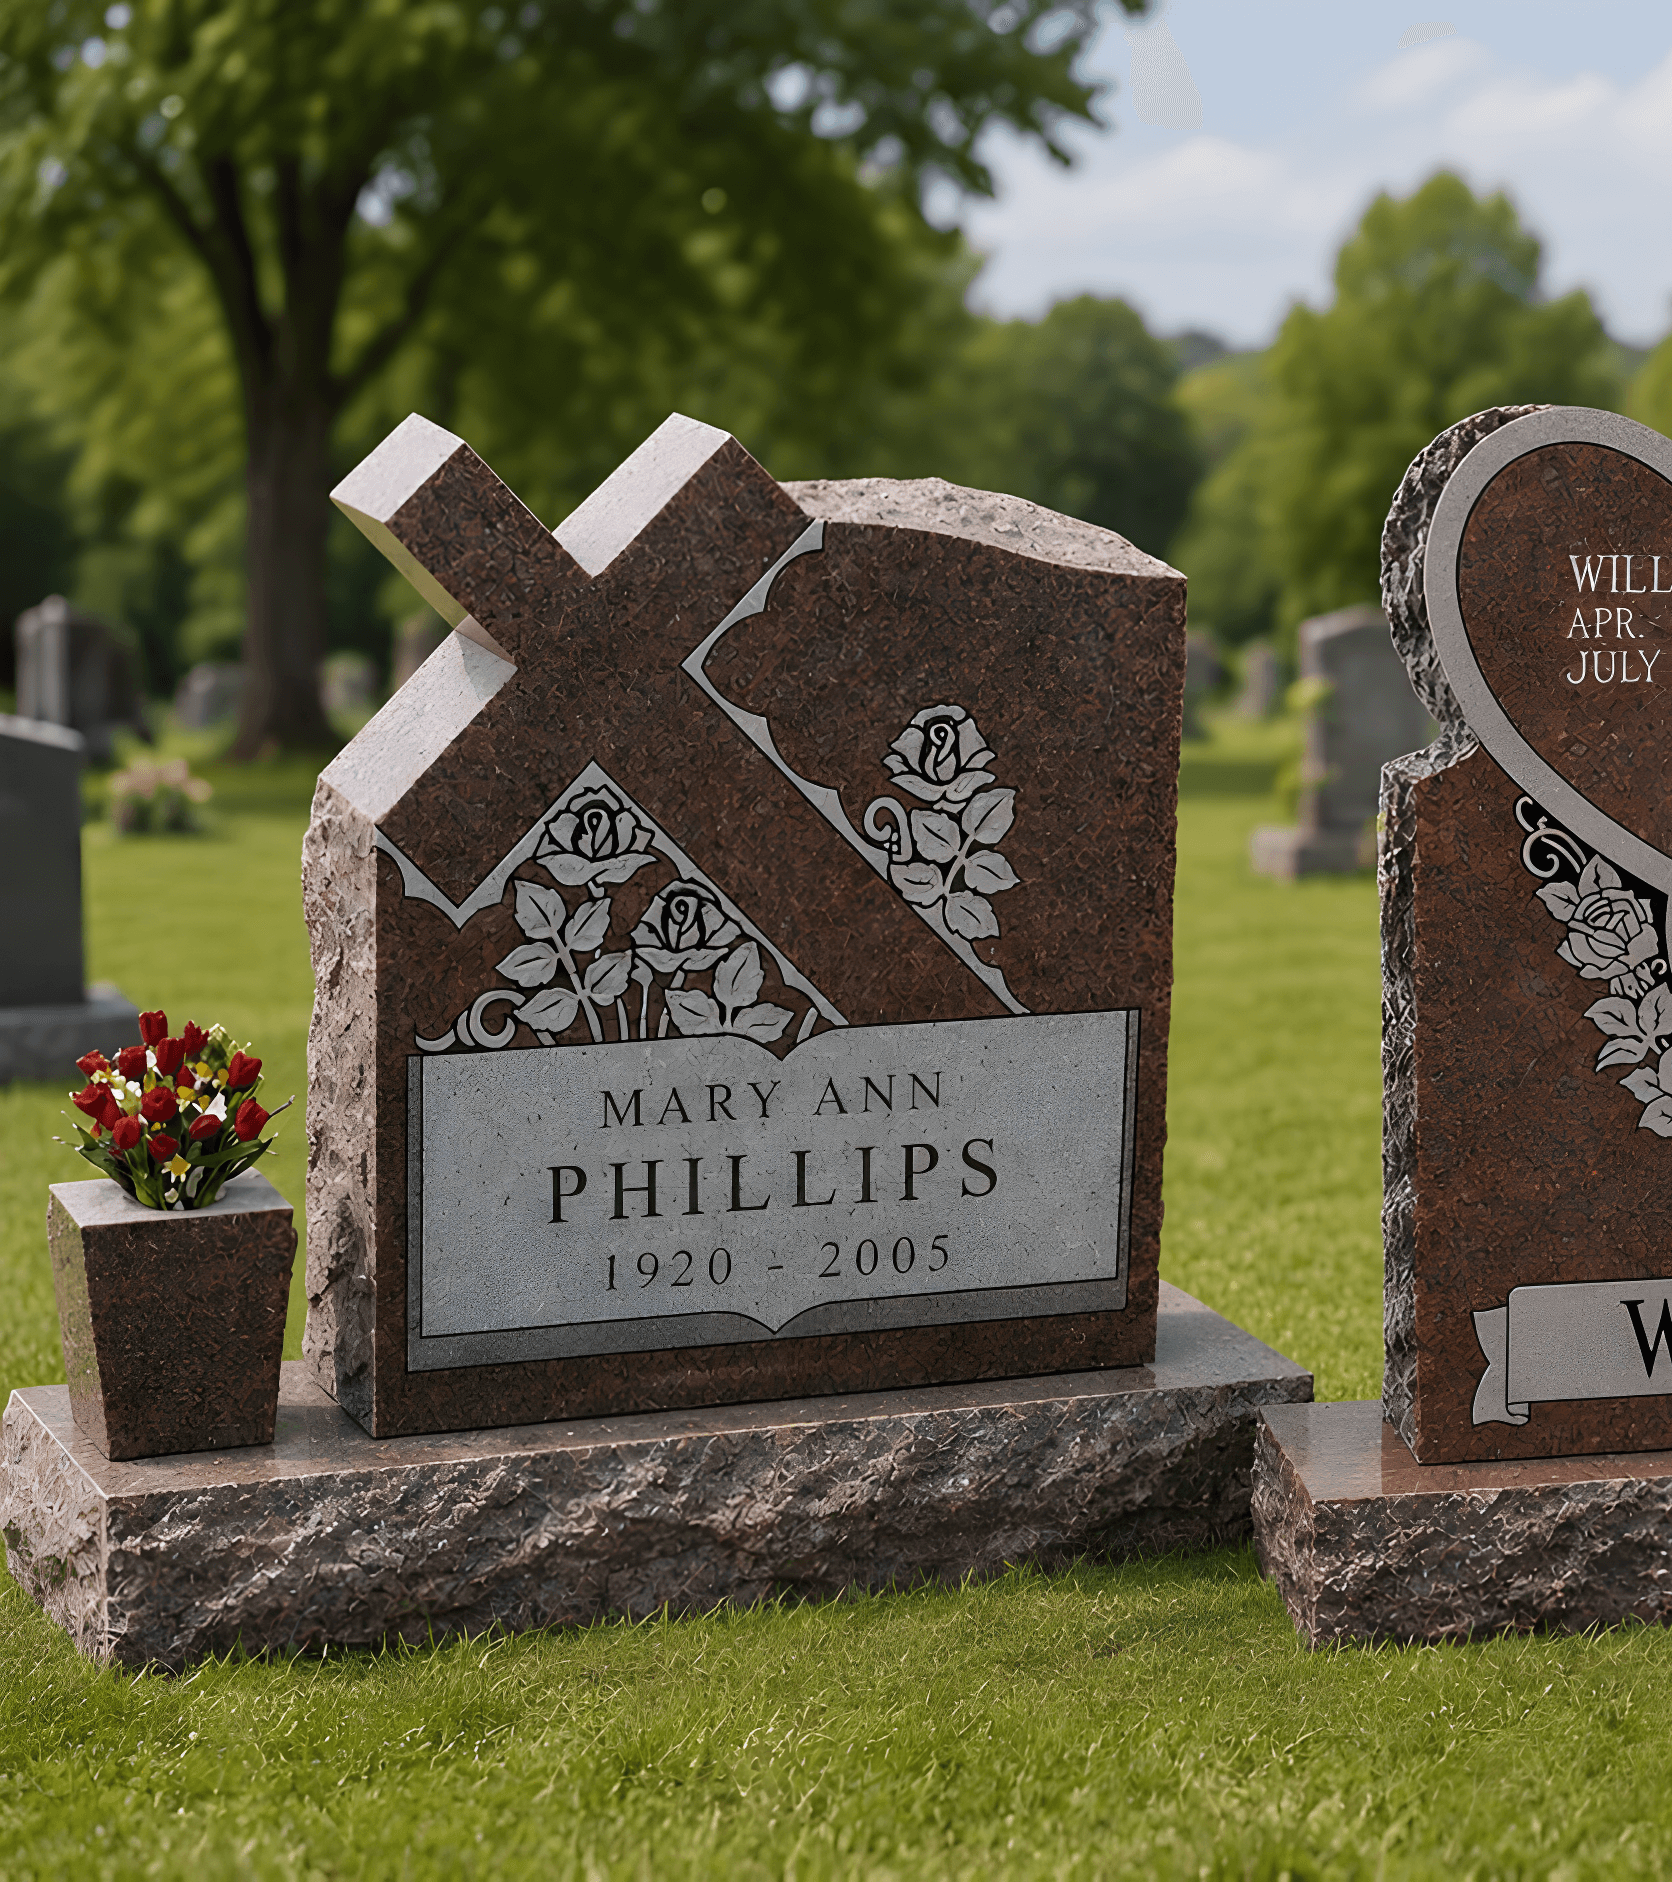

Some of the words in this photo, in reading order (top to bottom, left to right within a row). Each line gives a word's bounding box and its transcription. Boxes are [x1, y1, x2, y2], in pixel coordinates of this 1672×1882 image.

[1566, 607, 1645, 640] APR.
[1566, 649, 1661, 684] JULY
[600, 1080, 781, 1129] MARY
[812, 1071, 943, 1115] ANN
[546, 1138, 998, 1224] PHILLIPS
[606, 1247, 732, 1291] 1920
[818, 1234, 949, 1278] 2005
